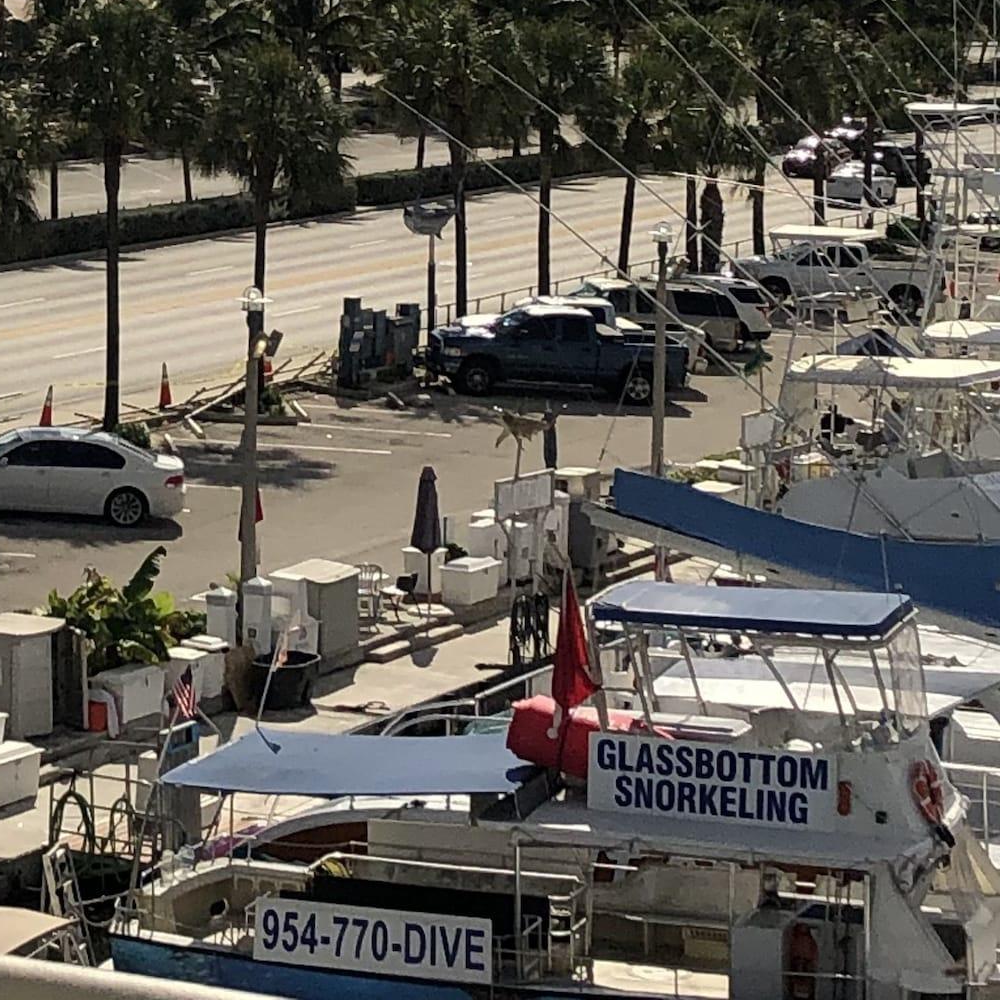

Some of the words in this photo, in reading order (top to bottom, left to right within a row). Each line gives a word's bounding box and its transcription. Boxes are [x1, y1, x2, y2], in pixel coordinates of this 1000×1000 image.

[597, 738, 828, 791] GLASSBOTTOM
[614, 775, 809, 825] SNORKELING
[262, 909, 485, 971] 954-770-DIVE
